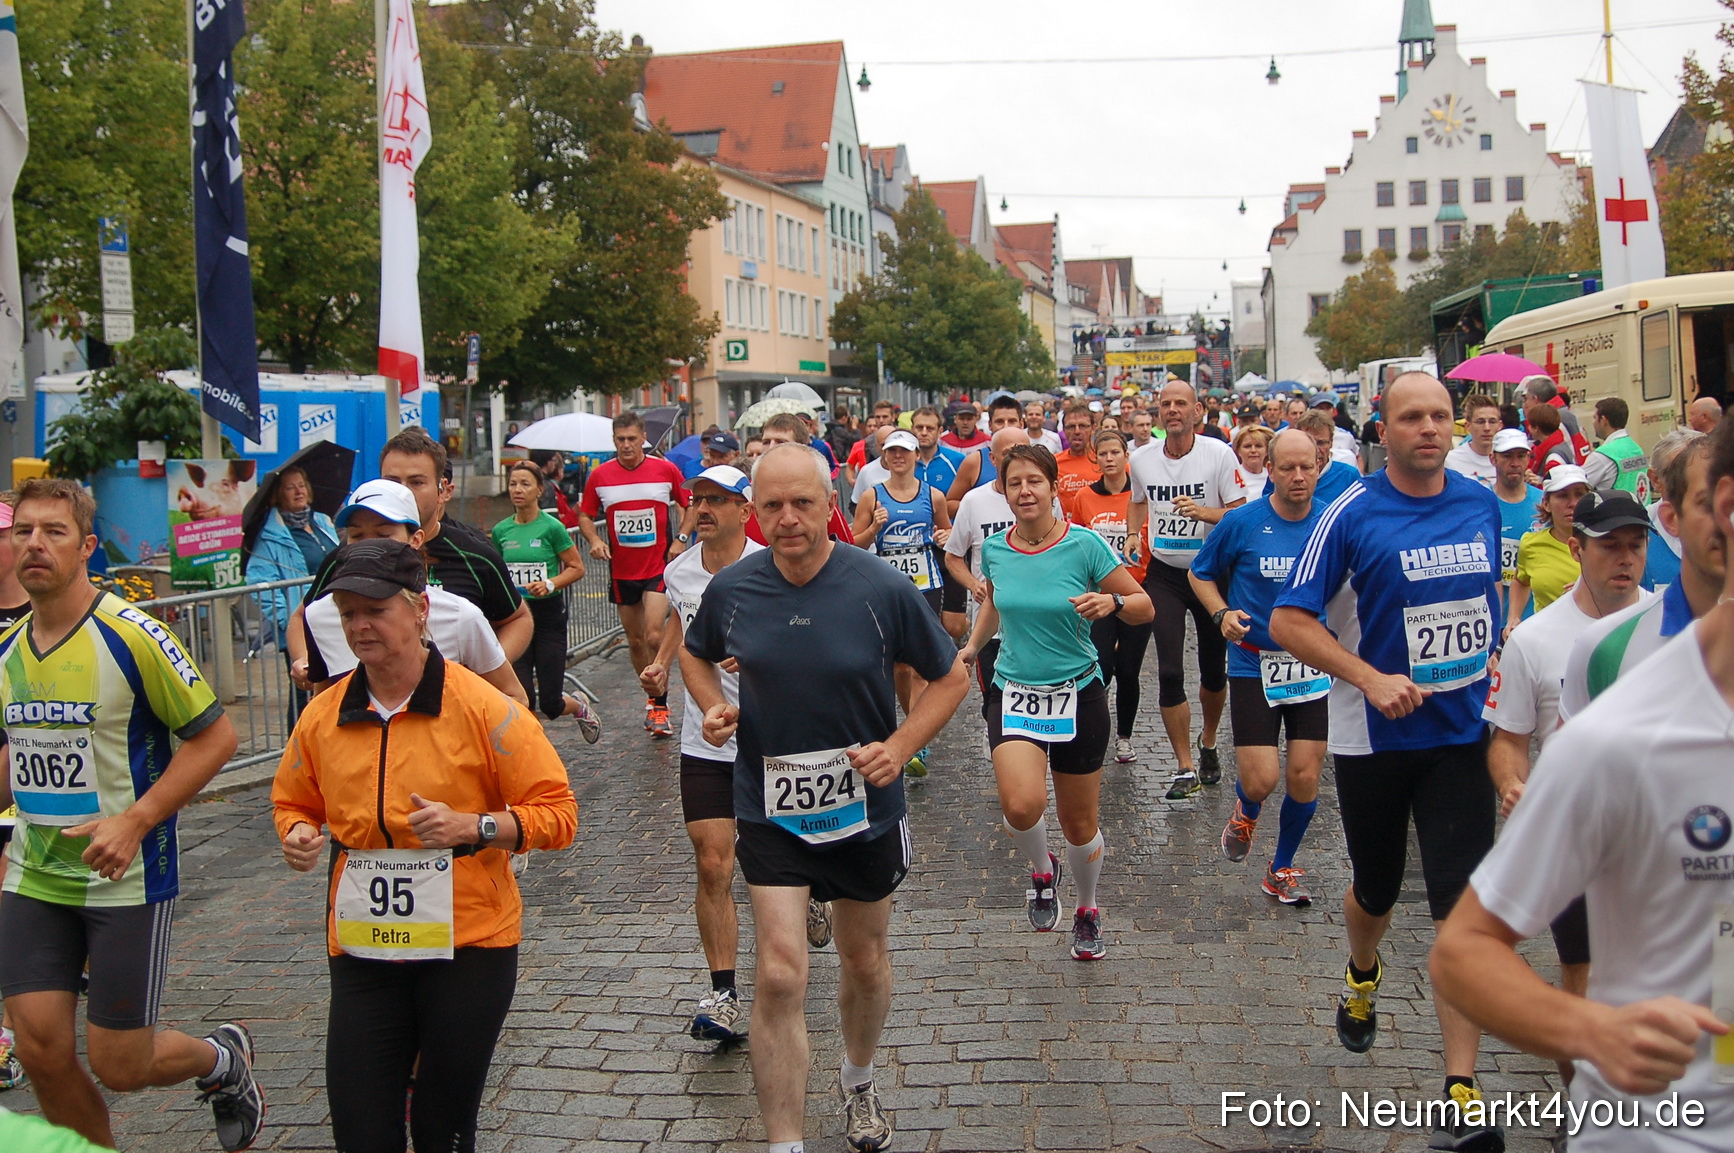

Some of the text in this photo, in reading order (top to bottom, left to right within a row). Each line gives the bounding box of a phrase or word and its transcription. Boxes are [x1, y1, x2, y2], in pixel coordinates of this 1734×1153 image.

[729, 342, 745, 358] D
[1564, 334, 1614, 360] Bayerisches
[1563, 362, 1587, 381] Rotes
[1234, 469, 1246, 488] 4
[1147, 483, 1204, 501] THULE
[619, 518, 652, 534] 2249
[1158, 519, 1199, 536] 2427
[1400, 542, 1488, 571] HUBER
[1423, 563, 1488, 577] TECHNOLOGY
[1407, 608, 1481, 625] PARTL Neumarkt
[118, 608, 201, 688] BOCK
[1418, 618, 1487, 660] 2769
[1431, 661, 1478, 680] Bernhard
[1286, 685, 1311, 696] Ralph
[5, 700, 96, 725] BOCK
[1010, 691, 1071, 716] 2817
[1023, 719, 1056, 733] Andrea
[9, 735, 73, 749] PARTL Neumarkt
[16, 752, 87, 788] 3062
[766, 757, 846, 772] PARTL Neumarkt
[775, 768, 855, 811] 2524
[800, 816, 840, 832] Armin
[346, 860, 430, 871] PARTL Neumarkt
[369, 876, 415, 917] 95
[372, 928, 411, 944] Petra
